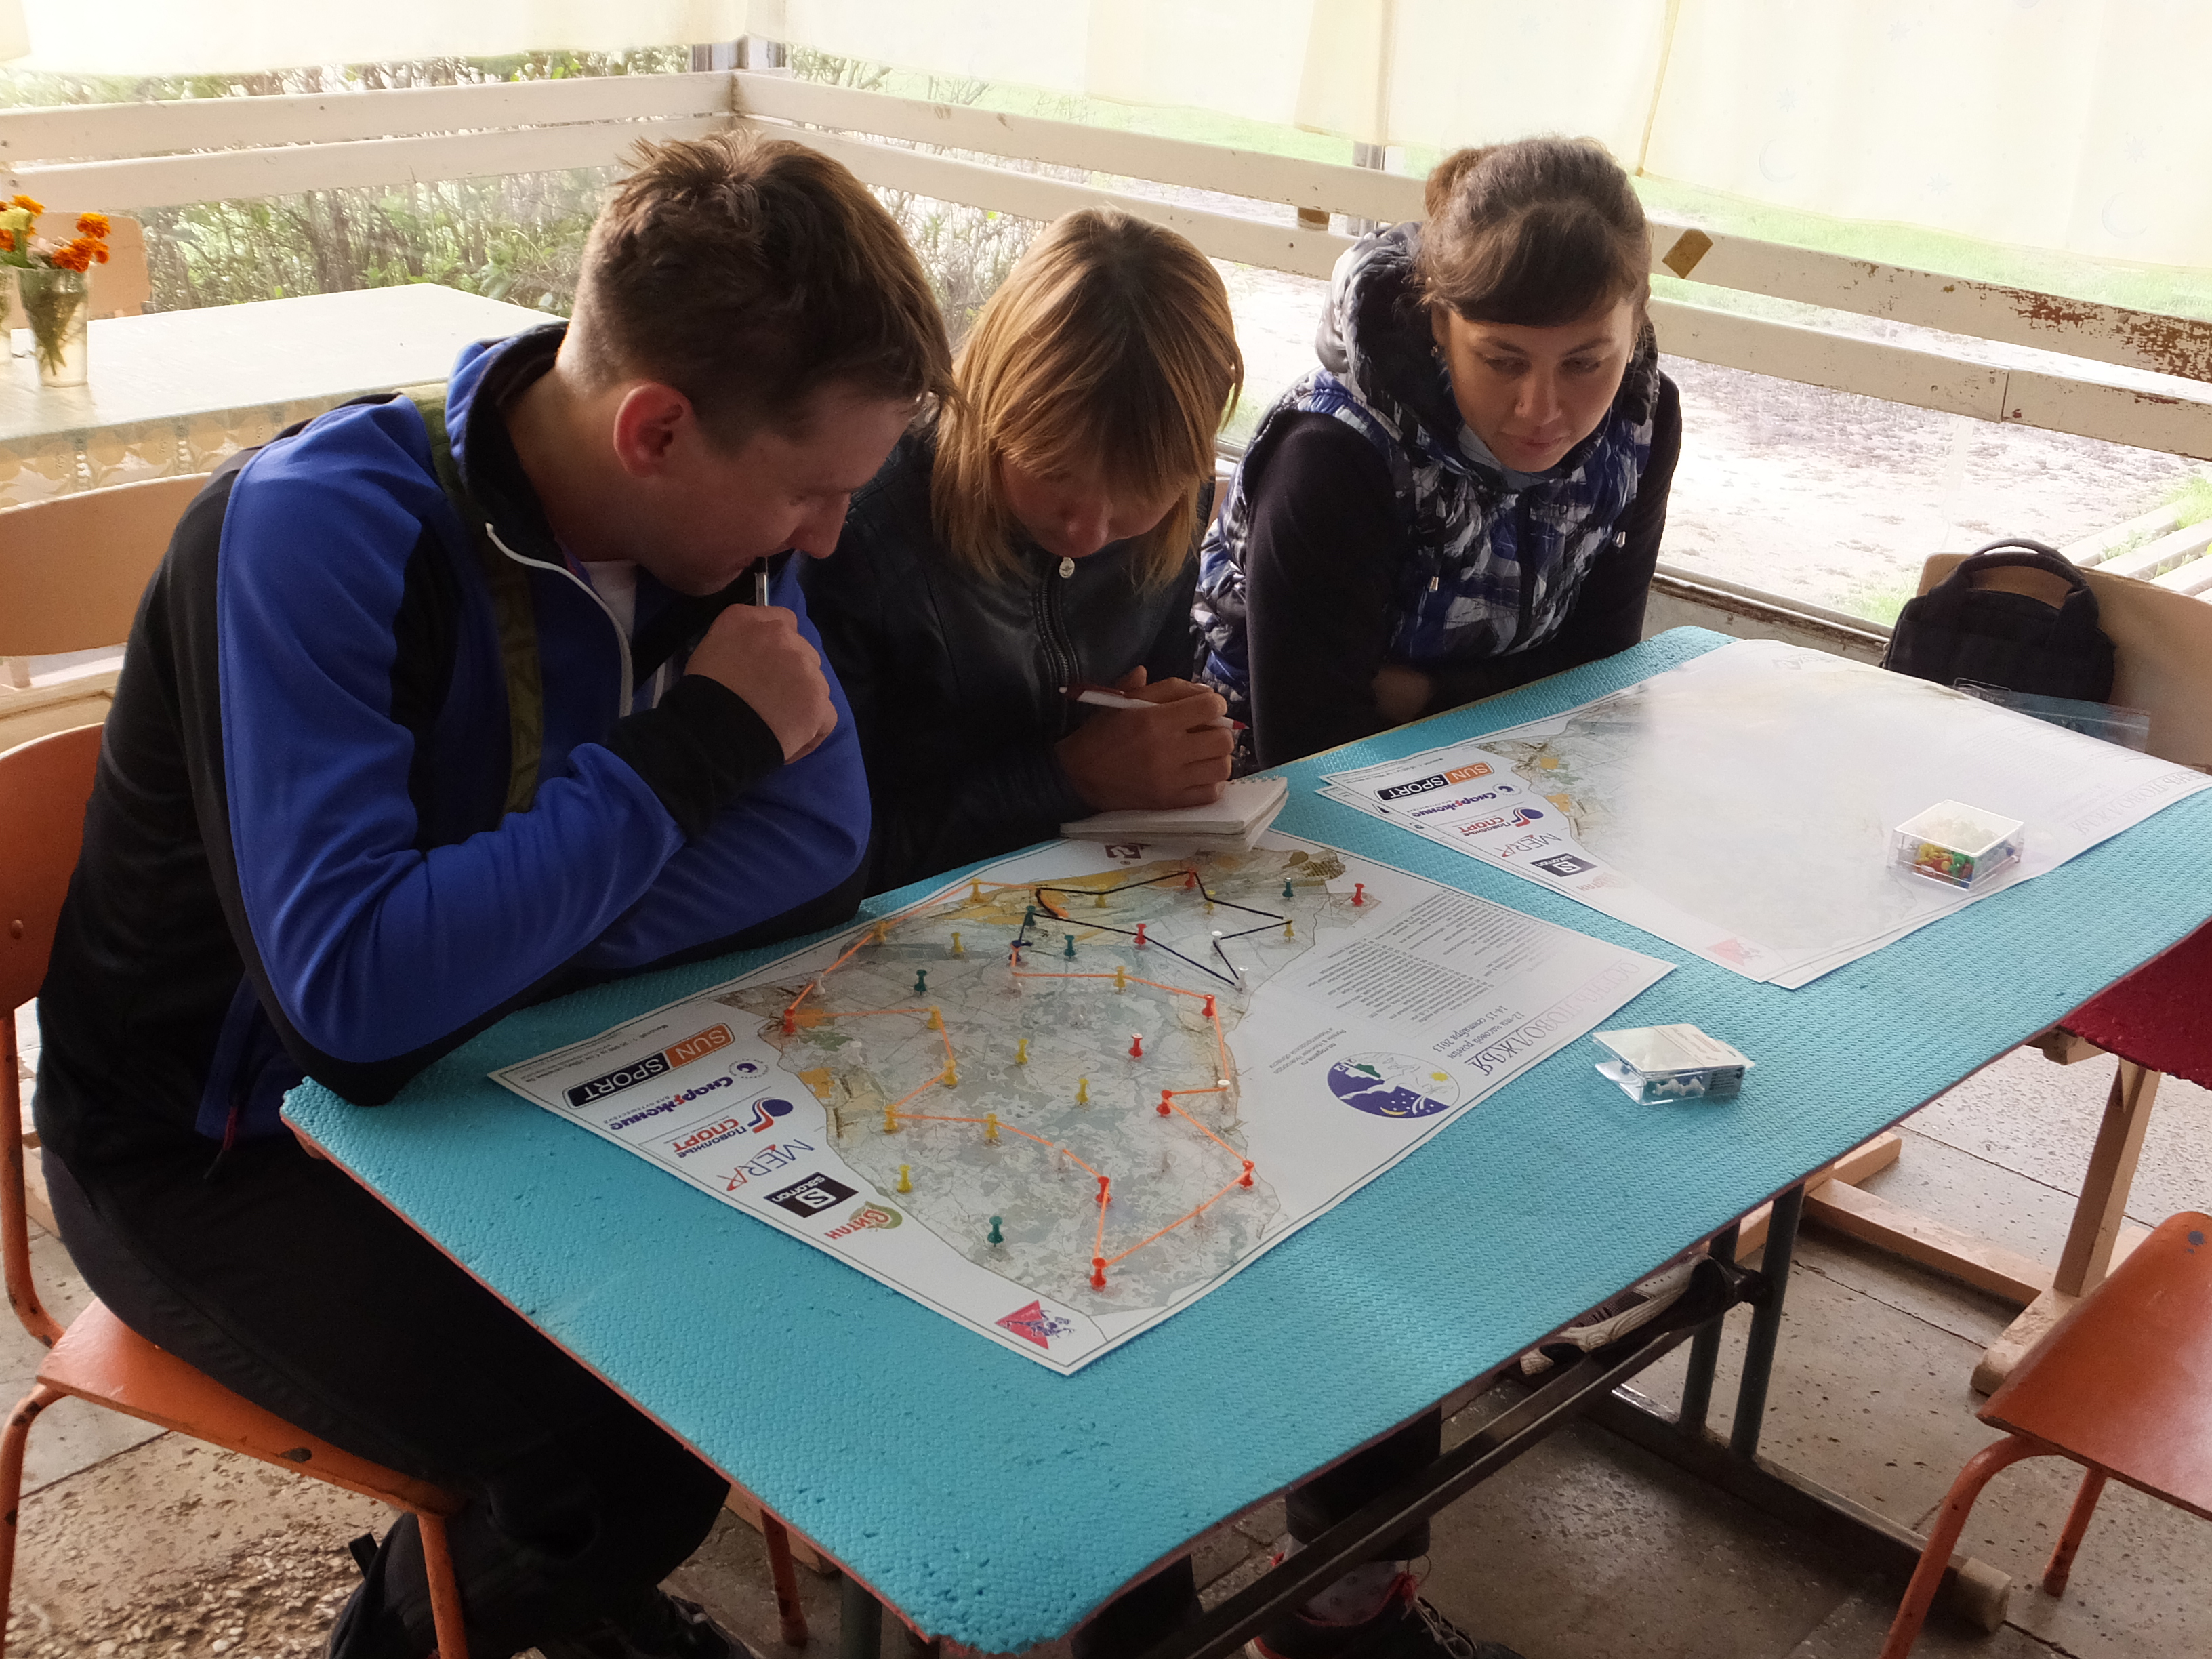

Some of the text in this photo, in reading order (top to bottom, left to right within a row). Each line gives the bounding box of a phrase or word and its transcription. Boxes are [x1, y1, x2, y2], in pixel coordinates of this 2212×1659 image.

[1389, 777, 1444, 798] SPORT
[1451, 764, 1488, 780] SUN
[1458, 817, 1504, 833] СПОРТ
[1432, 1005, 1508, 1052] 14-15 сентября 2013
[1468, 1001, 1583, 1076] ПОВОЛЖЬЯ
[675, 1029, 726, 1060] SUN
[585, 1058, 663, 1101] SPORT
[610, 1076, 733, 1130] Снаряжение
[672, 1118, 739, 1153] СПОРТ
[676, 1126, 747, 1158] Поволжье
[771, 1175, 825, 1203] salomon
[824, 1209, 890, 1240] Витан
